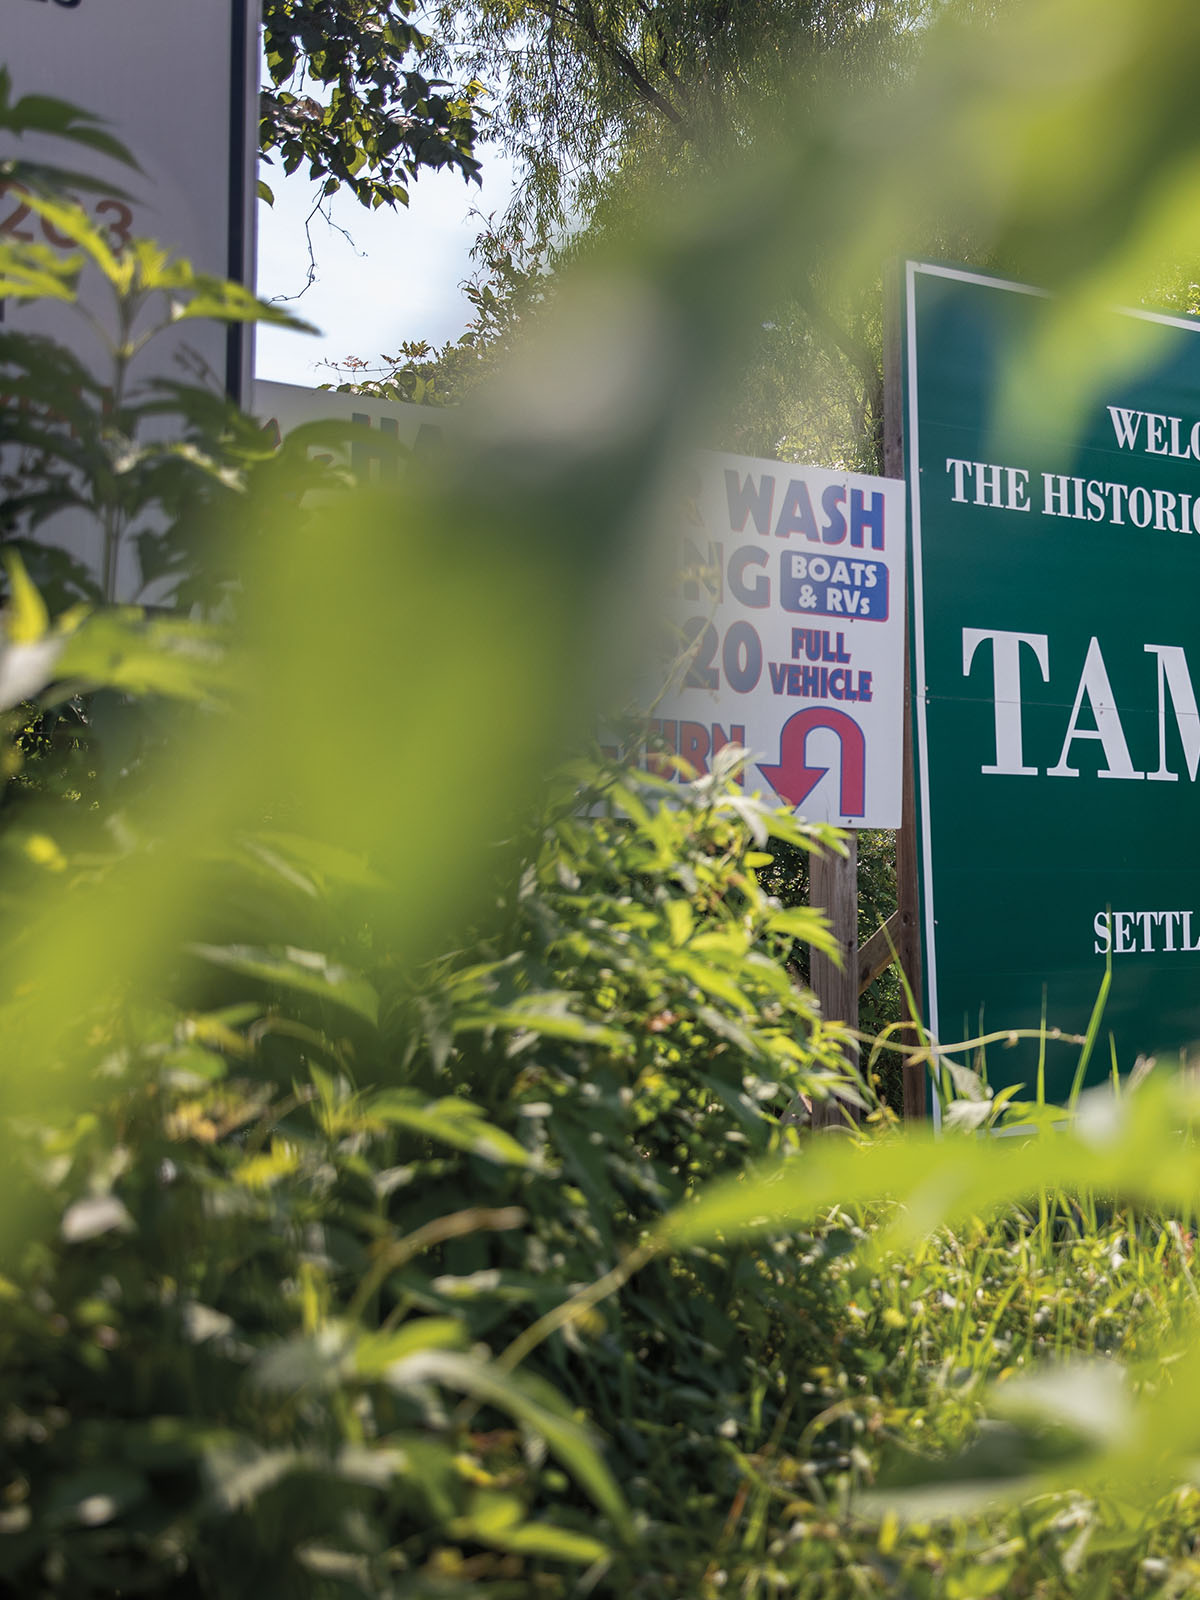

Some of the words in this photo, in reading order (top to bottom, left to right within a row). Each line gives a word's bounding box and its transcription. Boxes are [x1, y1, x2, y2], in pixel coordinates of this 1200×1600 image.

[946, 458, 1030, 512] THE
[724, 467, 885, 551] WASH
[791, 555, 877, 588] BOATS
[799, 584, 818, 610] &
[826, 587, 870, 615] RVs
[791, 627, 851, 664] FULL
[768, 662, 873, 702] VEHICLE
